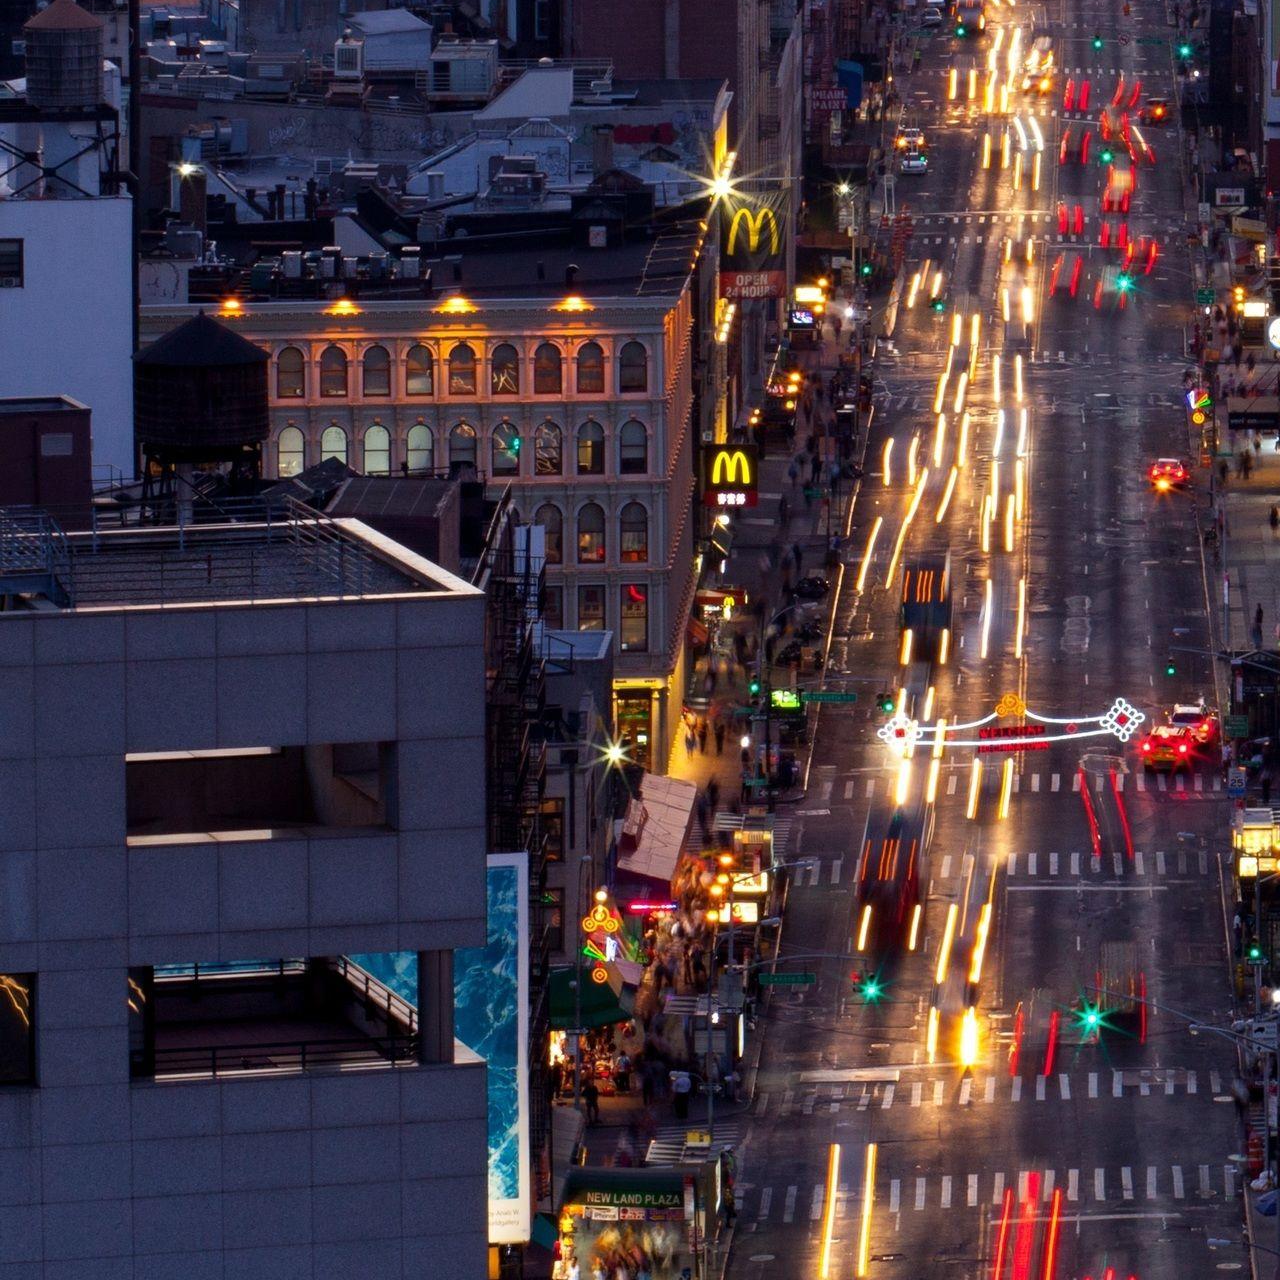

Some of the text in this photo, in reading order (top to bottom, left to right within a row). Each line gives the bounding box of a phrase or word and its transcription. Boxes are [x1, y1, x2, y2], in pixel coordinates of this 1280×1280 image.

[812, 90, 847, 100] PEARL
[812, 100, 847, 110] PAINT
[736, 274, 769, 286] OPEN
[726, 285, 777, 298] 24 HOURS
[587, 1191, 681, 1205] NEW LAND PLAZA
